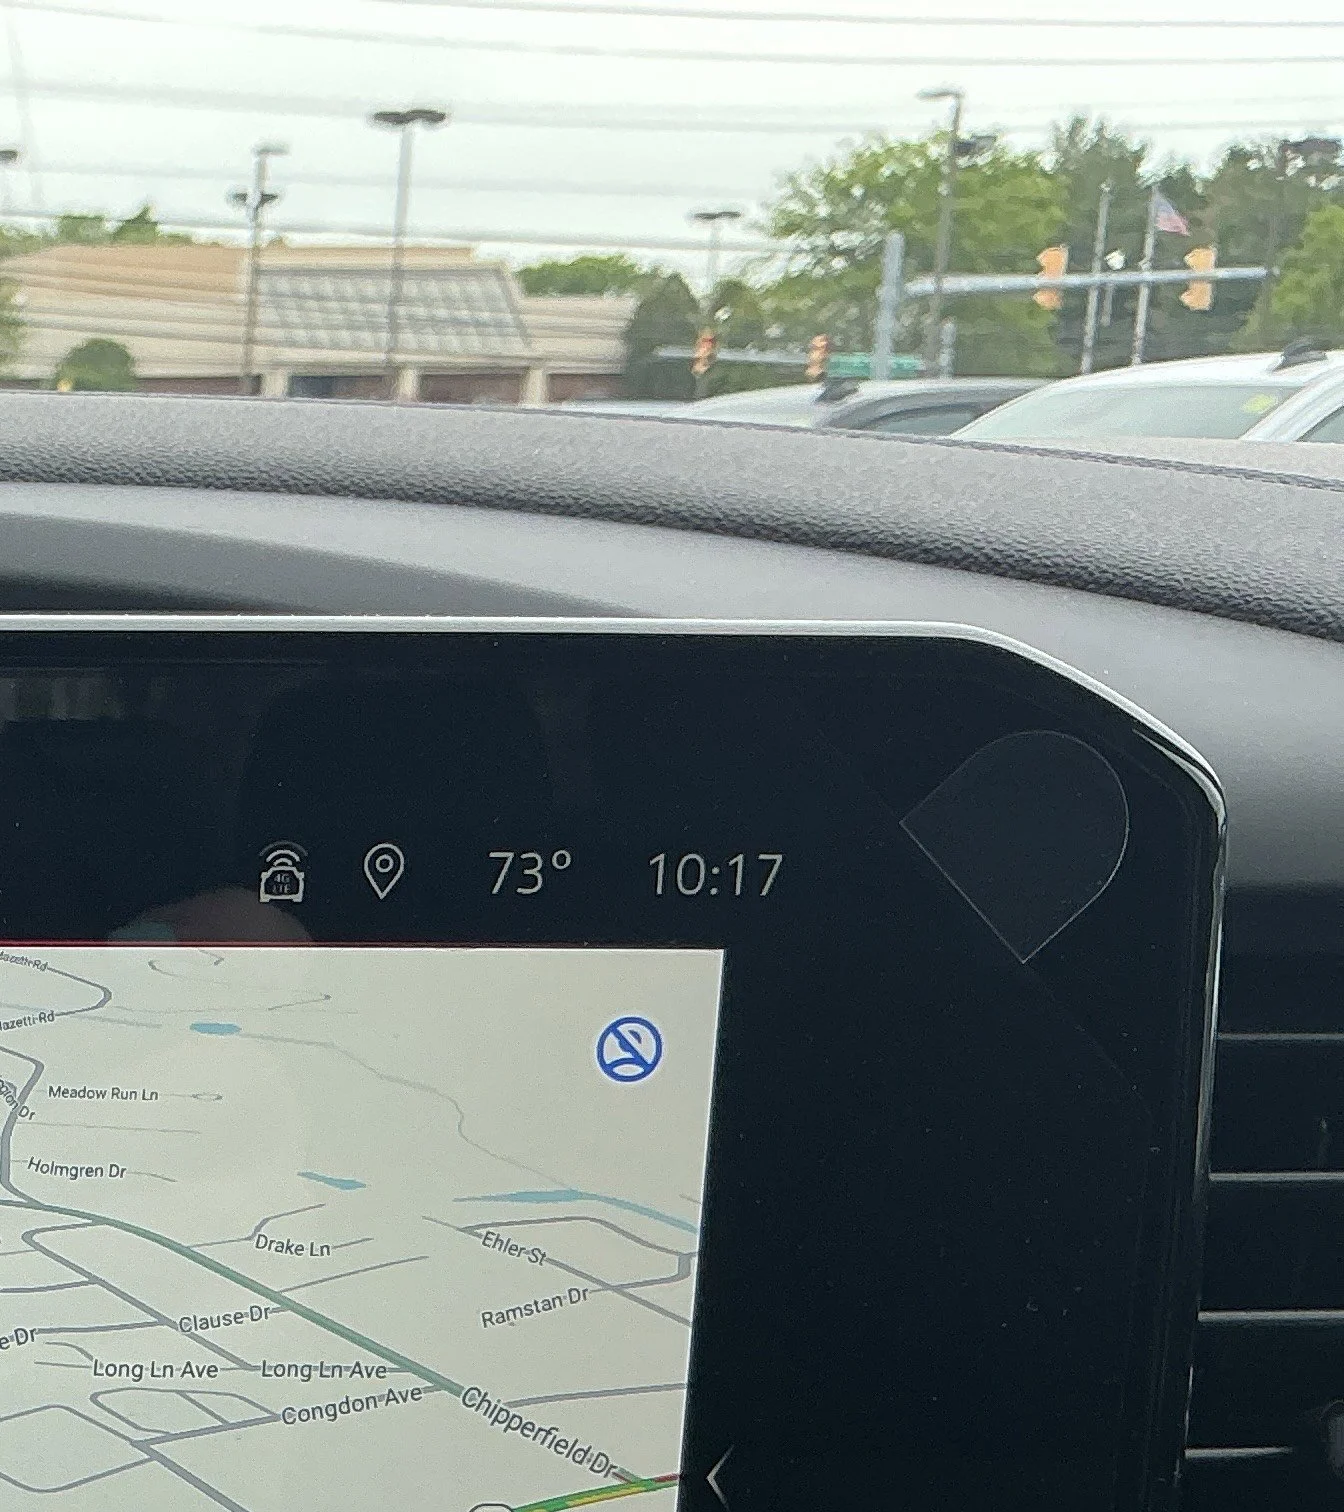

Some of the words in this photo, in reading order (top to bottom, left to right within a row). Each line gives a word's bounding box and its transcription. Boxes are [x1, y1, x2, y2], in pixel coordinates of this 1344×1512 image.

[648, 852, 783, 897] 10:17
[38, 1010, 55, 1023] Rd
[48, 1086, 107, 1100] Meadow
[111, 1088, 137, 1101] Run
[142, 1088, 159, 1101] Ln
[18, 1105, 35, 1120] Dr
[27, 1156, 104, 1181] Holmgren
[109, 1164, 127, 1179] Dr
[255, 1233, 305, 1257] Drake
[309, 1241, 330, 1257] Ln
[481, 1231, 526, 1259] Ehler
[526, 1247, 547, 1265] St
[178, 1310, 245, 1334] Clause
[248, 1304, 270, 1322] Dr
[482, 1293, 562, 1328] Ramstan
[567, 1286, 589, 1304] Dr
[14, 1327, 37, 1346] Dr
[92, 1360, 143, 1383] Long
[150, 1361, 174, 1378] Ln
[181, 1361, 219, 1379] Ave
[261, 1361, 312, 1382] Long
[319, 1362, 343, 1379] Ln
[349, 1361, 388, 1379] Ave
[281, 1394, 378, 1425] Congdon
[384, 1387, 423, 1406] Ave
[462, 1387, 593, 1466] Chipperfield
[589, 1453, 616, 1477] Dr
